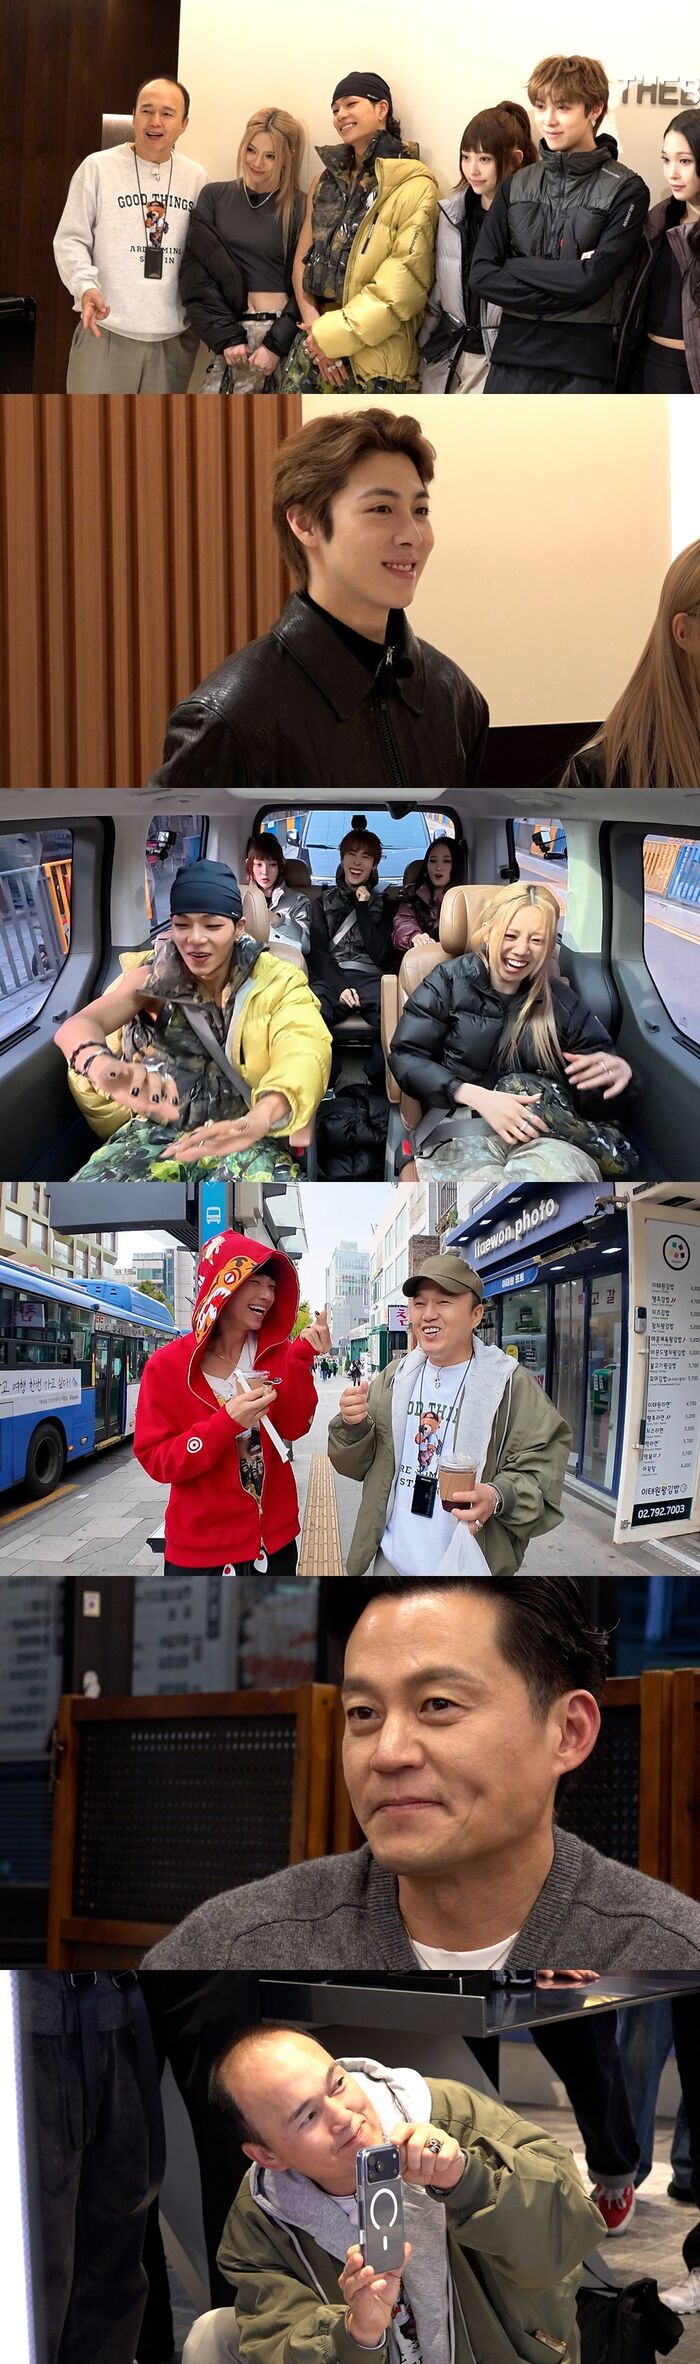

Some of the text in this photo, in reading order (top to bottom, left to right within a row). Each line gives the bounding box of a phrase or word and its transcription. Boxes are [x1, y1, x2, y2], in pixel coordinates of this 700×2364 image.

[118, 194, 194, 213] GOOD THINGS
[515, 1198, 559, 1242] photo
[0, 1380, 10, 1394] 고
[641, 1484, 680, 1496] 이태원왕김밥
[637, 1504, 685, 1519] 02.792.7003
